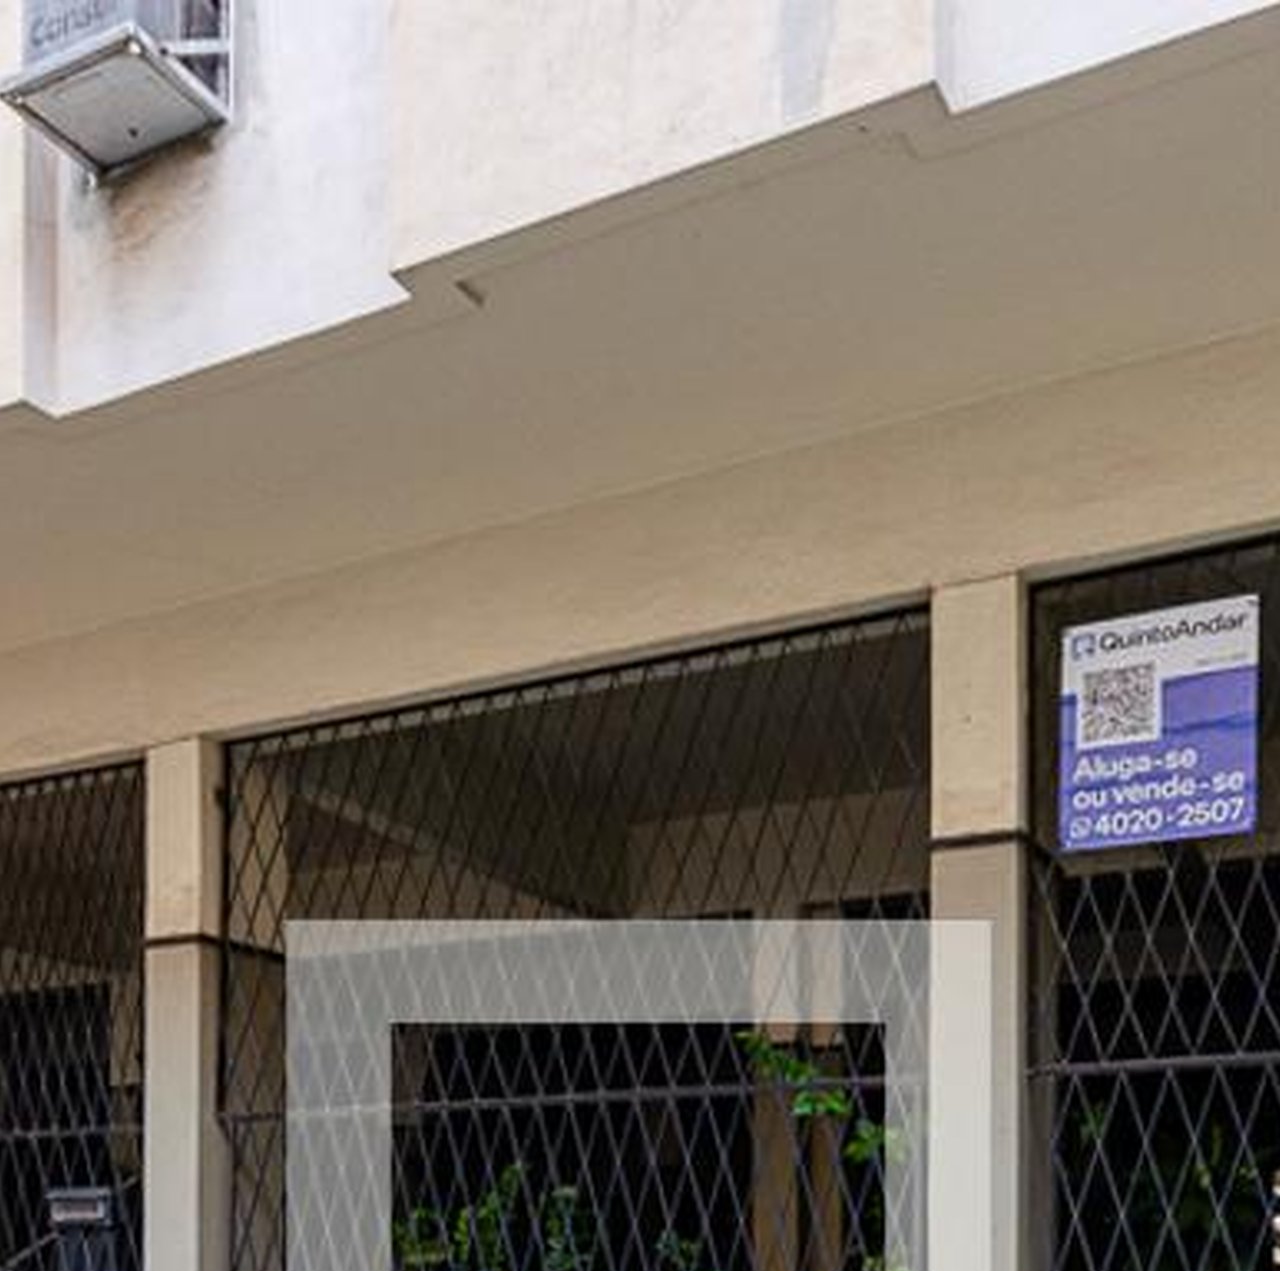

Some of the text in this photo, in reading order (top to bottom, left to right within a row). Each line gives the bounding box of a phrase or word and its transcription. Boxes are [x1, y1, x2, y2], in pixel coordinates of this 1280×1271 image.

[1099, 612, 1248, 652] QuintoAndar
[1074, 748, 1198, 782] Aluga-se
[1073, 771, 1245, 811] ou vende-se
[1095, 797, 1245, 836] 4020-2507
